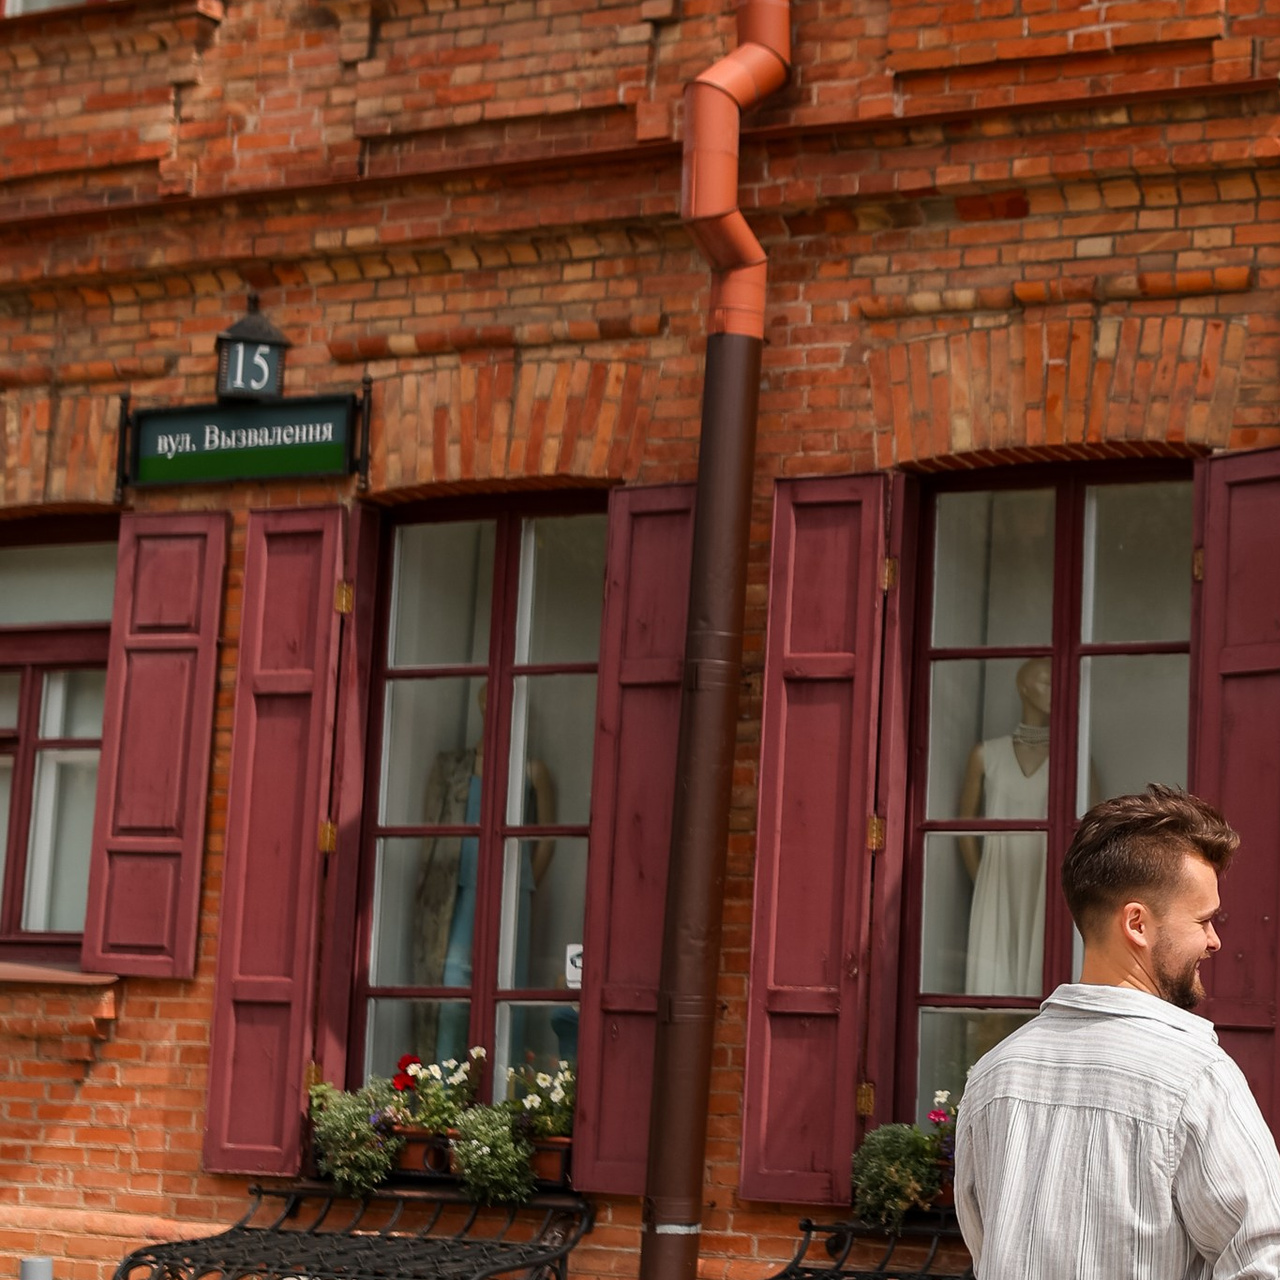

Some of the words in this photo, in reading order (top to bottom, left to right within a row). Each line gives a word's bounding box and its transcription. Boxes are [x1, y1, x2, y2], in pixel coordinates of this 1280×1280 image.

[232, 341, 270, 390] 15
[156, 431, 197, 459] вул.
[203, 421, 334, 451] Вызвалення
